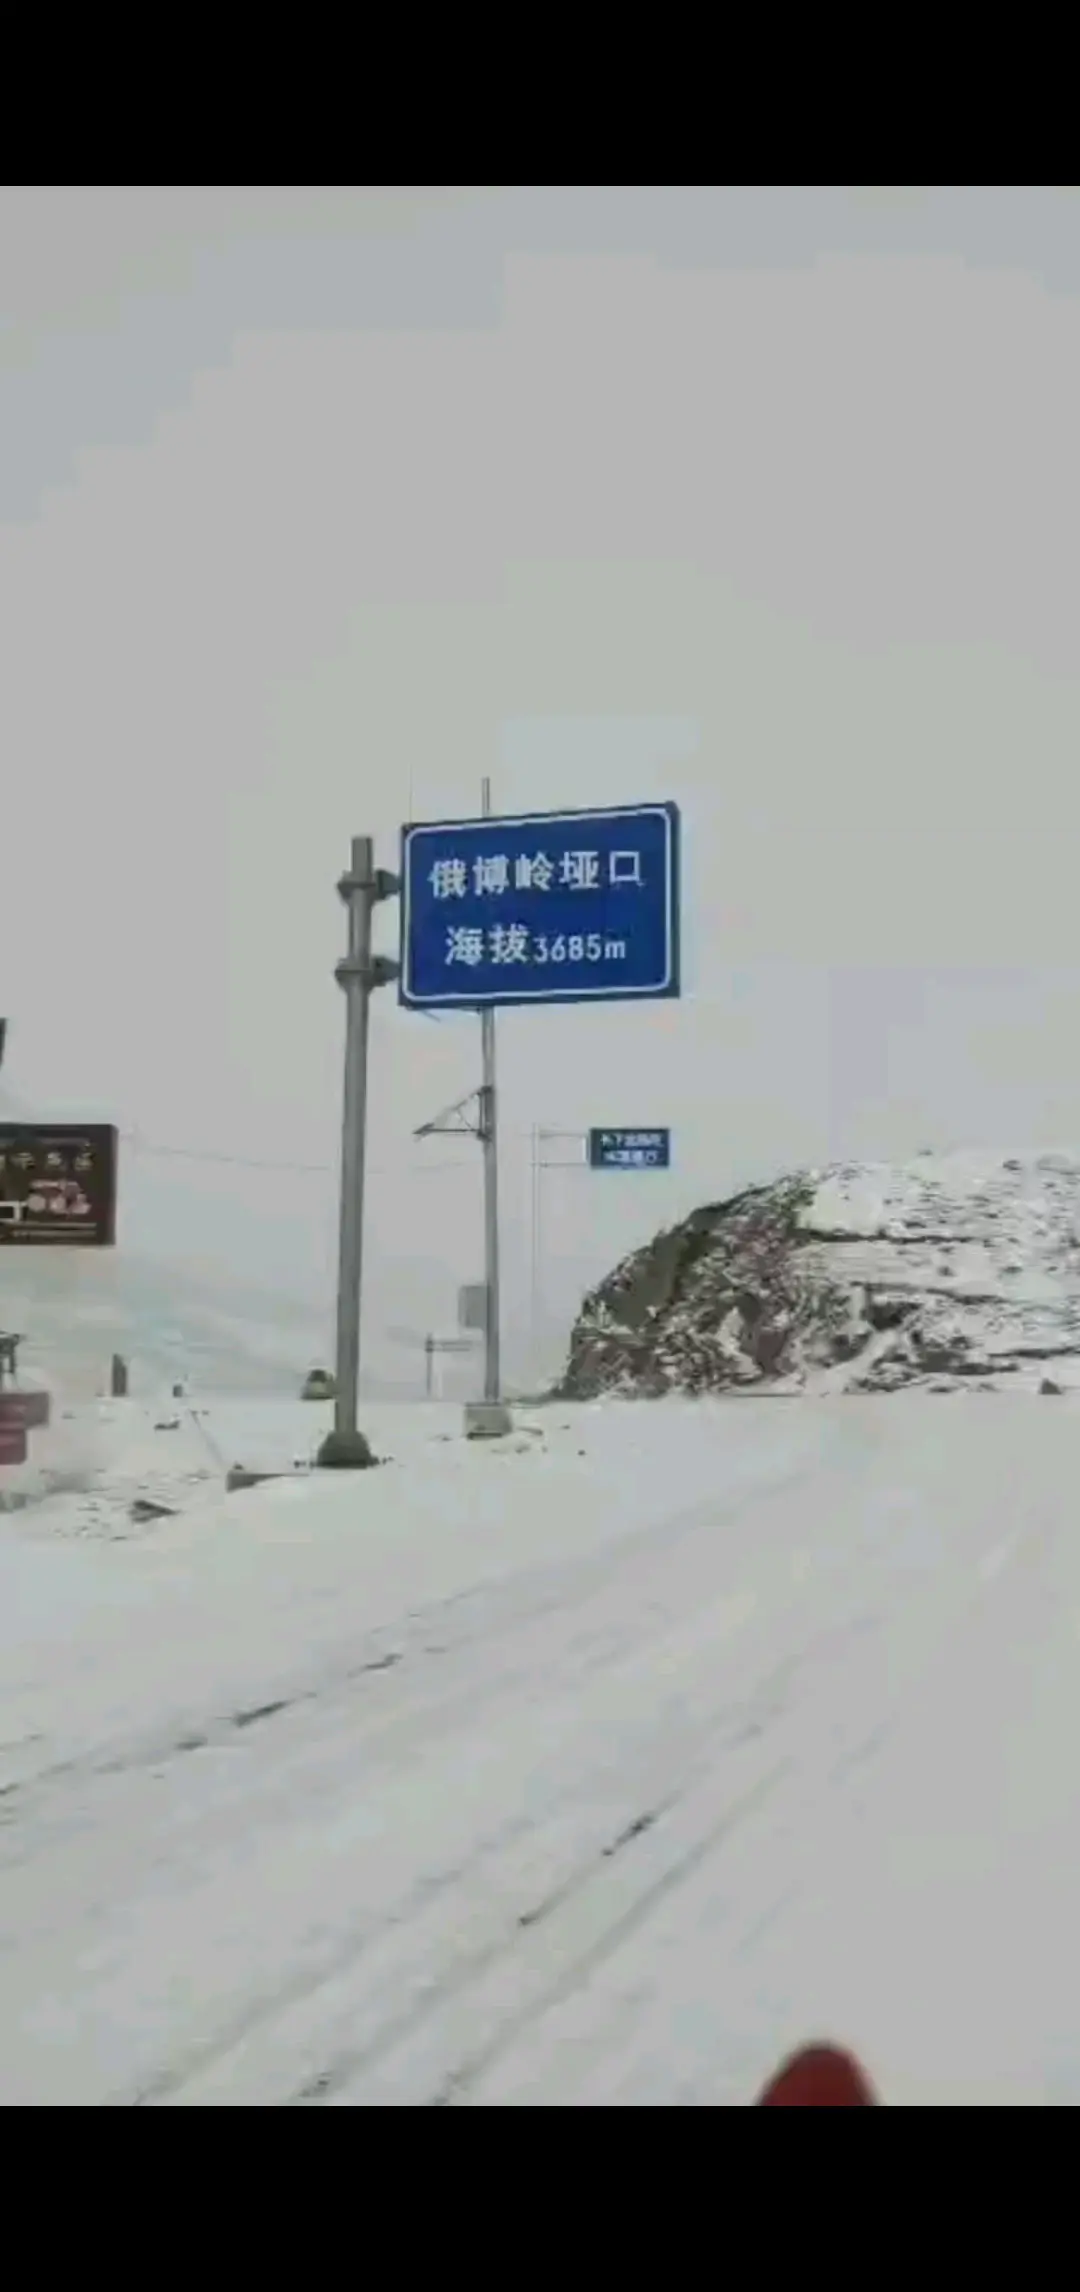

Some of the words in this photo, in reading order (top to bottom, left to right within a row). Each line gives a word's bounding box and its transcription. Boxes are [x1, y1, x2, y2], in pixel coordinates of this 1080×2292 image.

[429, 851, 642, 898] 俄博岭垭口
[445, 924, 626, 965] 海拔3685m
